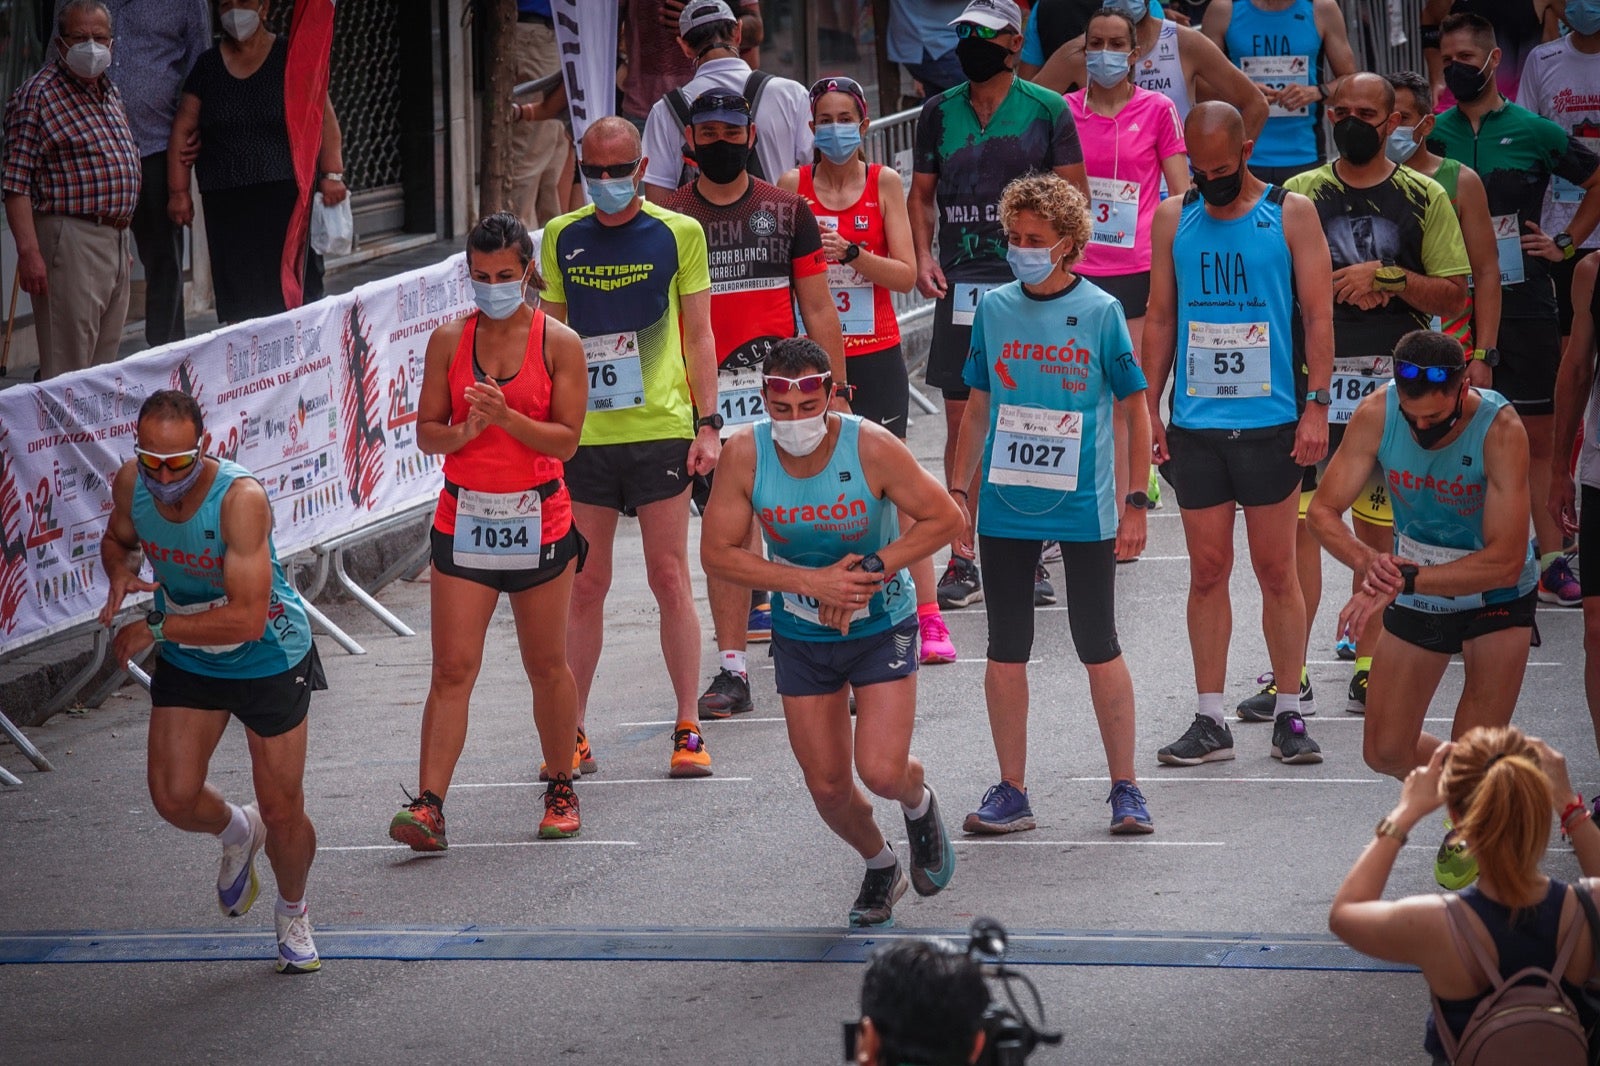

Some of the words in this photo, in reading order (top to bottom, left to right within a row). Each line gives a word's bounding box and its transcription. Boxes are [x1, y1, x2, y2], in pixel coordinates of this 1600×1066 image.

[945, 205, 980, 223] MALA
[1097, 203, 1109, 223] 3
[708, 222, 743, 246] CEM
[734, 247, 768, 262] BLANCA
[567, 263, 654, 276] ATLETISMO
[1200, 251, 1248, 295] ENA
[570, 272, 649, 291] ALHENDÍN
[836, 291, 851, 313] 3
[1238, 301, 1244, 312] y
[389, 317, 440, 343] DIPUTACIÓN
[1002, 338, 1090, 365] atracón
[1040, 363, 1088, 379] running
[1214, 351, 1245, 375] 53
[587, 364, 617, 389] 76
[1061, 378, 1087, 394] loja
[217, 377, 276, 405] DIPUTACIÓN
[277, 371, 293, 386] DE
[1216, 385, 1239, 396] JORGE
[1332, 378, 1376, 401] 184
[594, 398, 614, 409] JORGE
[721, 395, 763, 419] 112
[1007, 441, 1066, 467] 1027
[1389, 468, 1482, 497] atracón
[761, 493, 867, 525] atracón
[813, 516, 869, 532] running
[471, 525, 529, 548] 1034
[1413, 599, 1429, 610] JOSE
